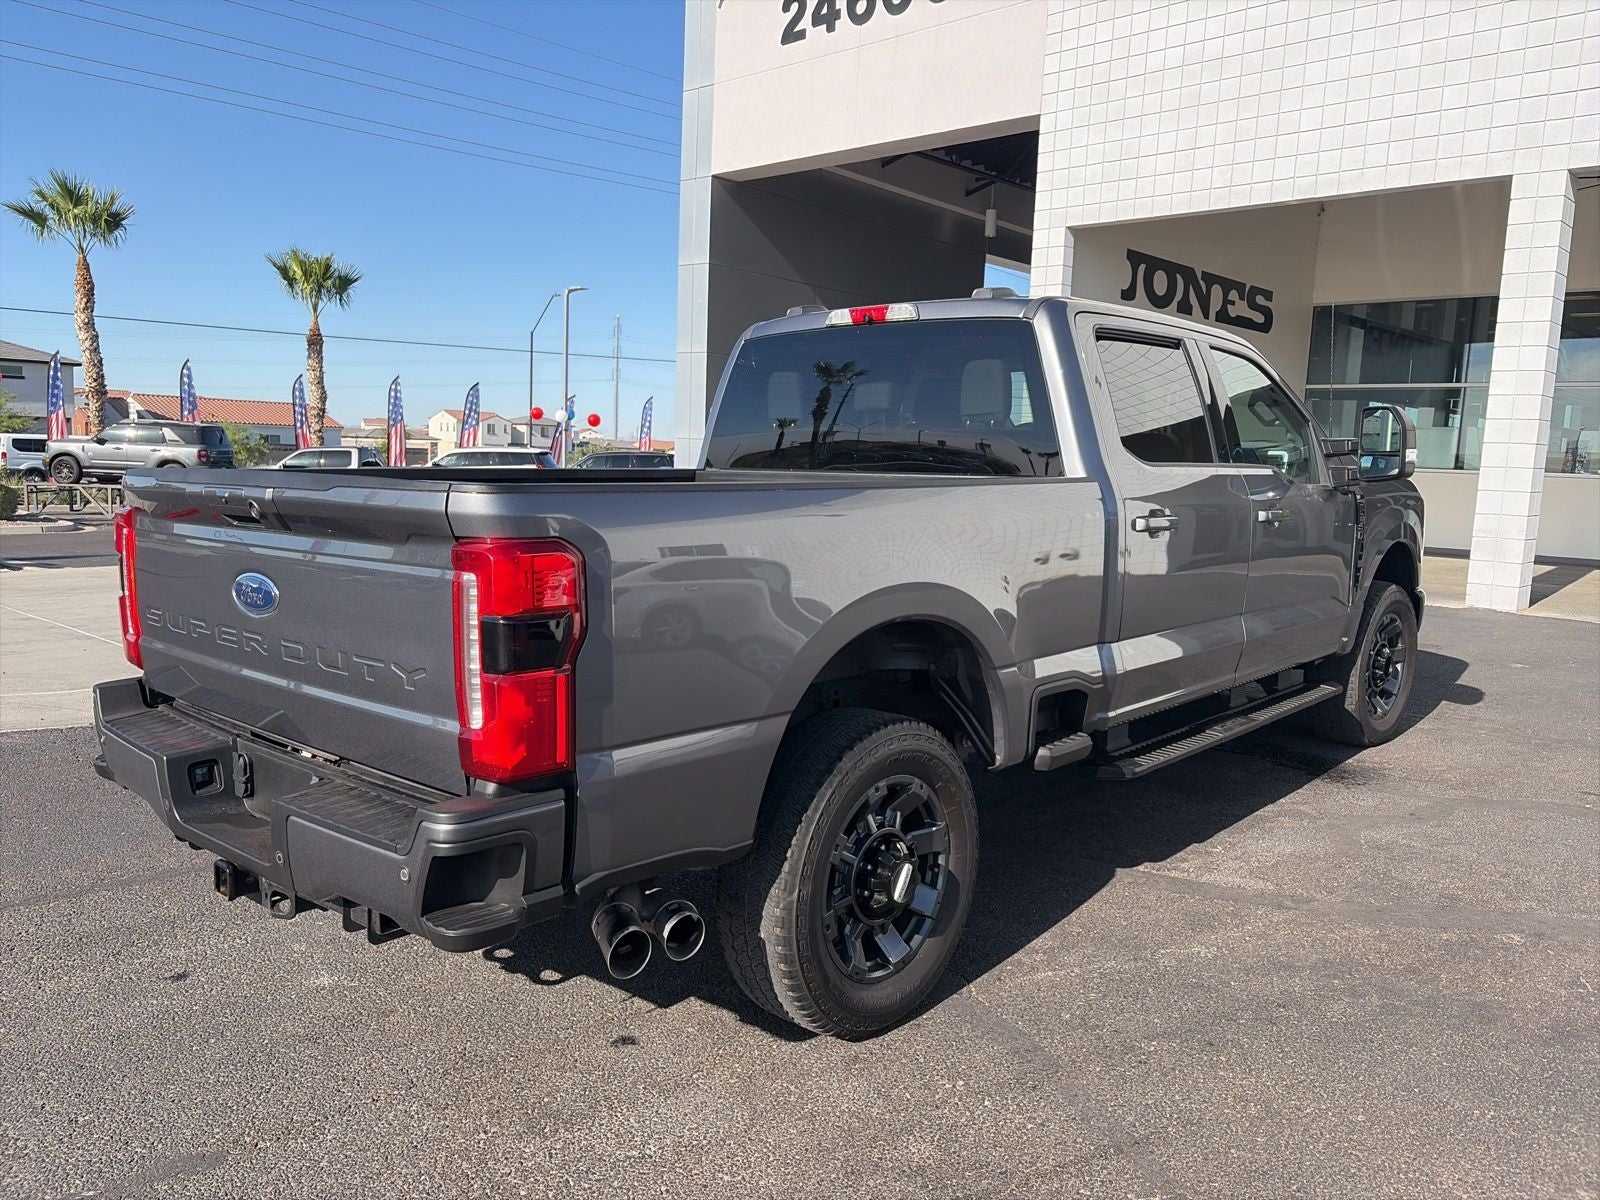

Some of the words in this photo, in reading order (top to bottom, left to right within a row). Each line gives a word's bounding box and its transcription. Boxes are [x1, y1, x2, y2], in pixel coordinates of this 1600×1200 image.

[780, 0, 946, 46] 246
[1120, 248, 1274, 334] JONES
[146, 608, 269, 656] SUPER
[280, 638, 427, 691] DUTY
